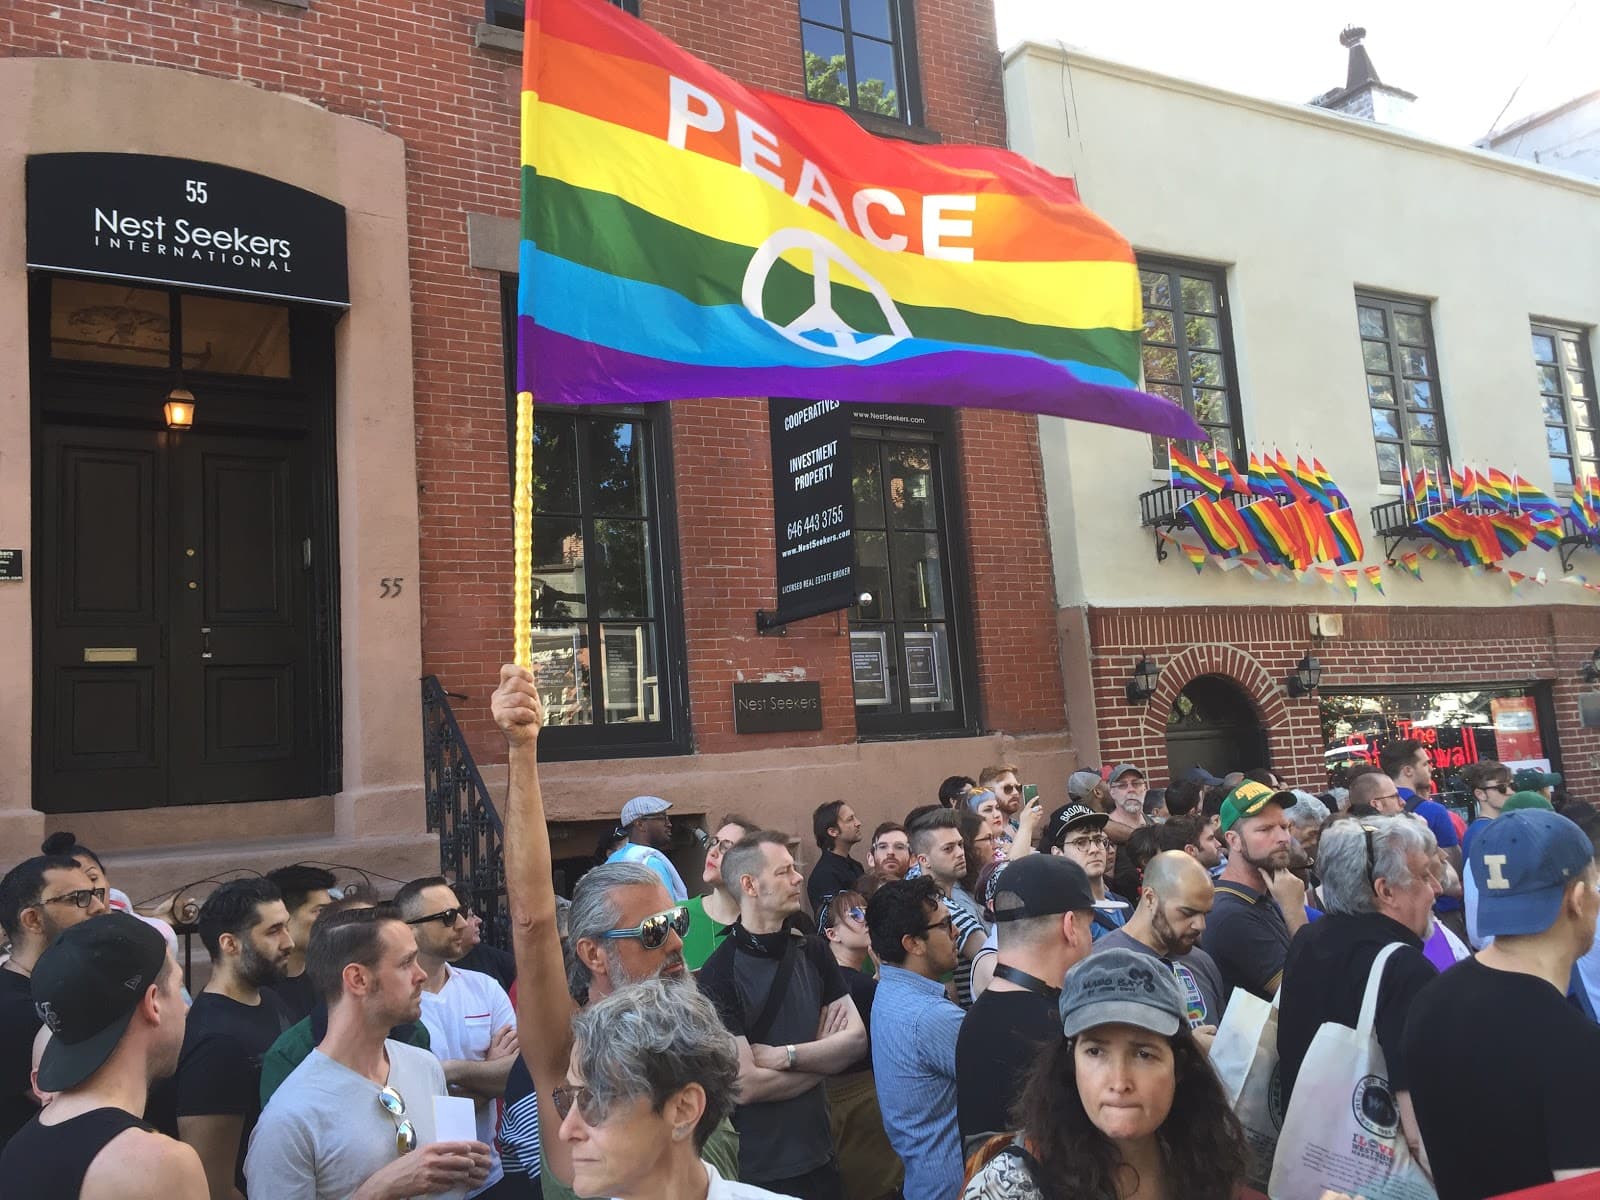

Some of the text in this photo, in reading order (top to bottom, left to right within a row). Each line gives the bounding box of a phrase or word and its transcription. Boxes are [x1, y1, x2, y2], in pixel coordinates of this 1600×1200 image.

[667, 75, 977, 263] PEACE
[186, 179, 208, 204] 55
[95, 207, 291, 258] Nest Seekers
[95, 236, 291, 273] INTERNATIONAL
[784, 399, 840, 431] COOPERATIVES
[853, 411, 926, 424] www.NestSeekers.com
[789, 440, 838, 473] INVESTMENT
[794, 462, 834, 492] PROPERTY
[787, 504, 844, 540] 646 443 3755
[782, 529, 851, 558] www.NestSeekers.com
[380, 577, 404, 599] 55
[782, 566, 851, 594] LICENSED REAL ESTATE BROKER
[738, 696, 817, 711] Nest Seekers
[1396, 719, 1436, 744] The
[1483, 854, 1510, 890] I
